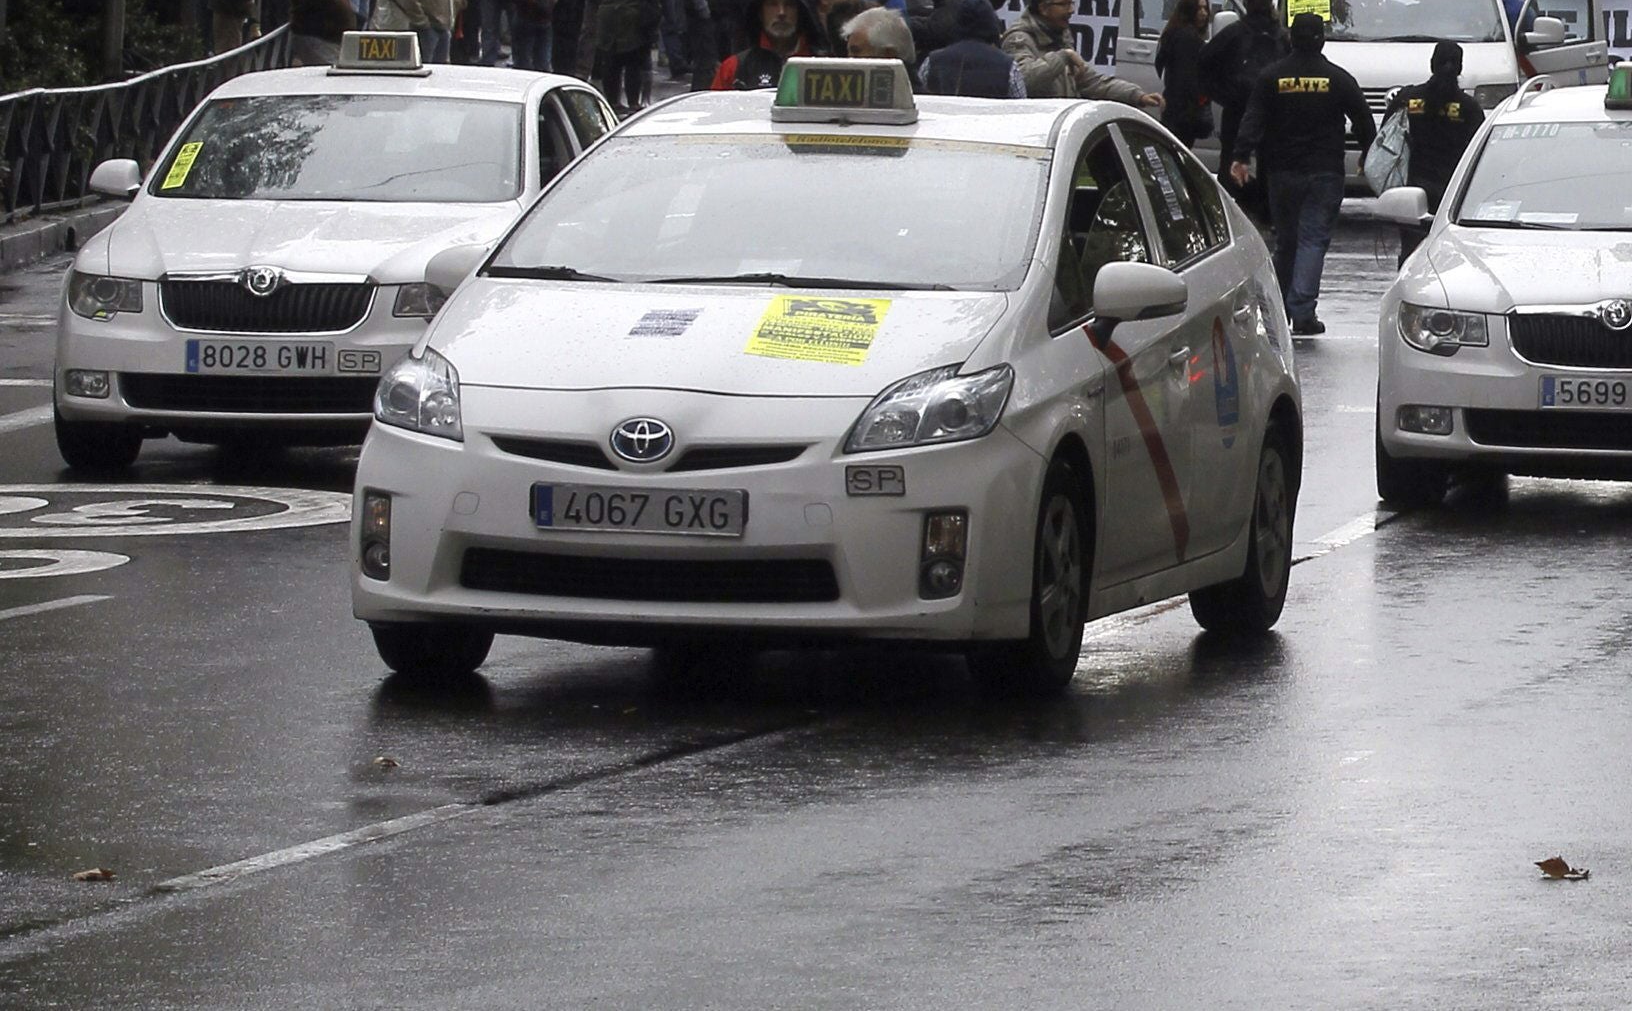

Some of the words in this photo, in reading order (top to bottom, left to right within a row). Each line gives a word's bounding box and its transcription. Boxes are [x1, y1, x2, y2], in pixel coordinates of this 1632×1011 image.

[360, 38, 396, 59] TAXI
[808, 74, 863, 102] TAXI
[1278, 77, 1330, 93] ELITE
[203, 345, 267, 368] 8028
[277, 346, 327, 370] GWH
[343, 352, 379, 368] SP
[1560, 380, 1627, 406] 5699
[853, 470, 897, 491] SP
[563, 491, 650, 527] 4067
[664, 495, 729, 530] GXG
